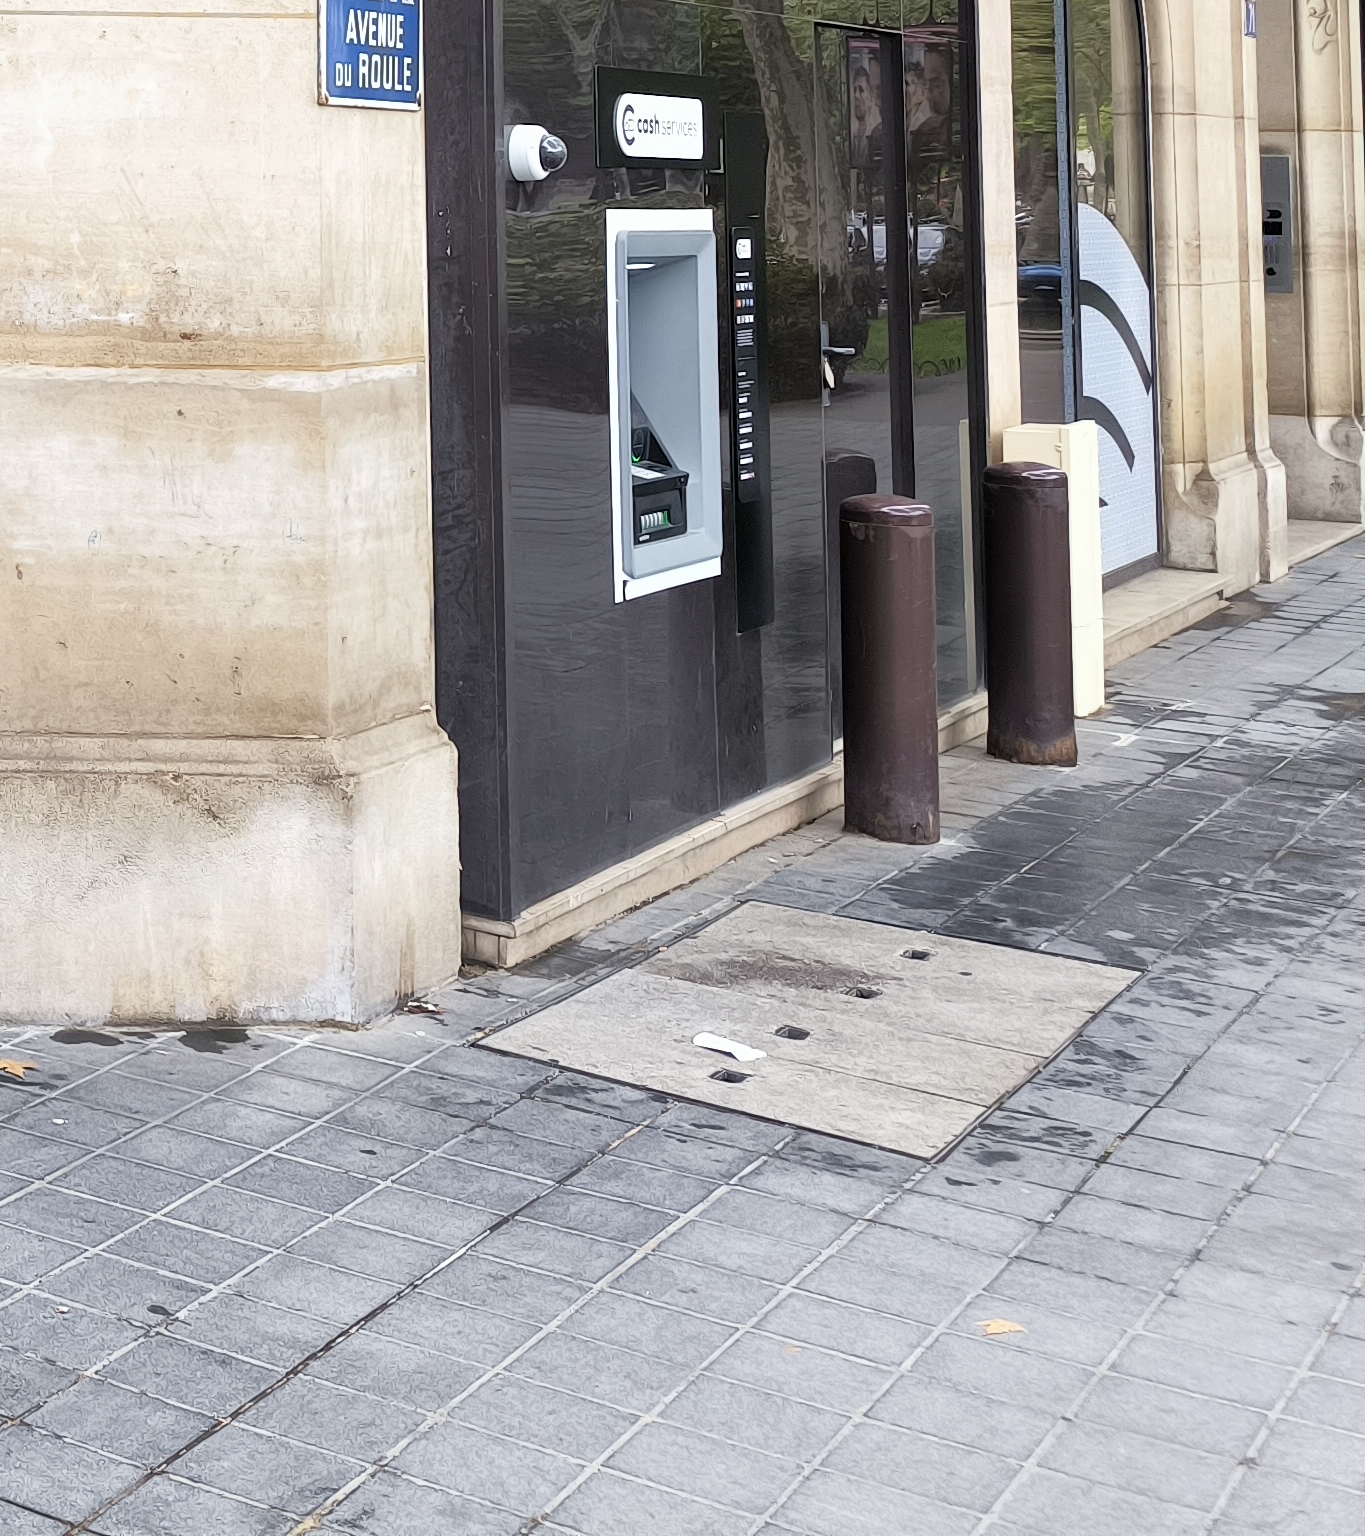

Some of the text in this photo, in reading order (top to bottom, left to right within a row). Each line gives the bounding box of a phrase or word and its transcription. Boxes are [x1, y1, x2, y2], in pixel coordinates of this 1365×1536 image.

[346, 8, 404, 49] AVENUE
[335, 52, 412, 92] DU ROULE
[637, 112, 699, 137] cash services
